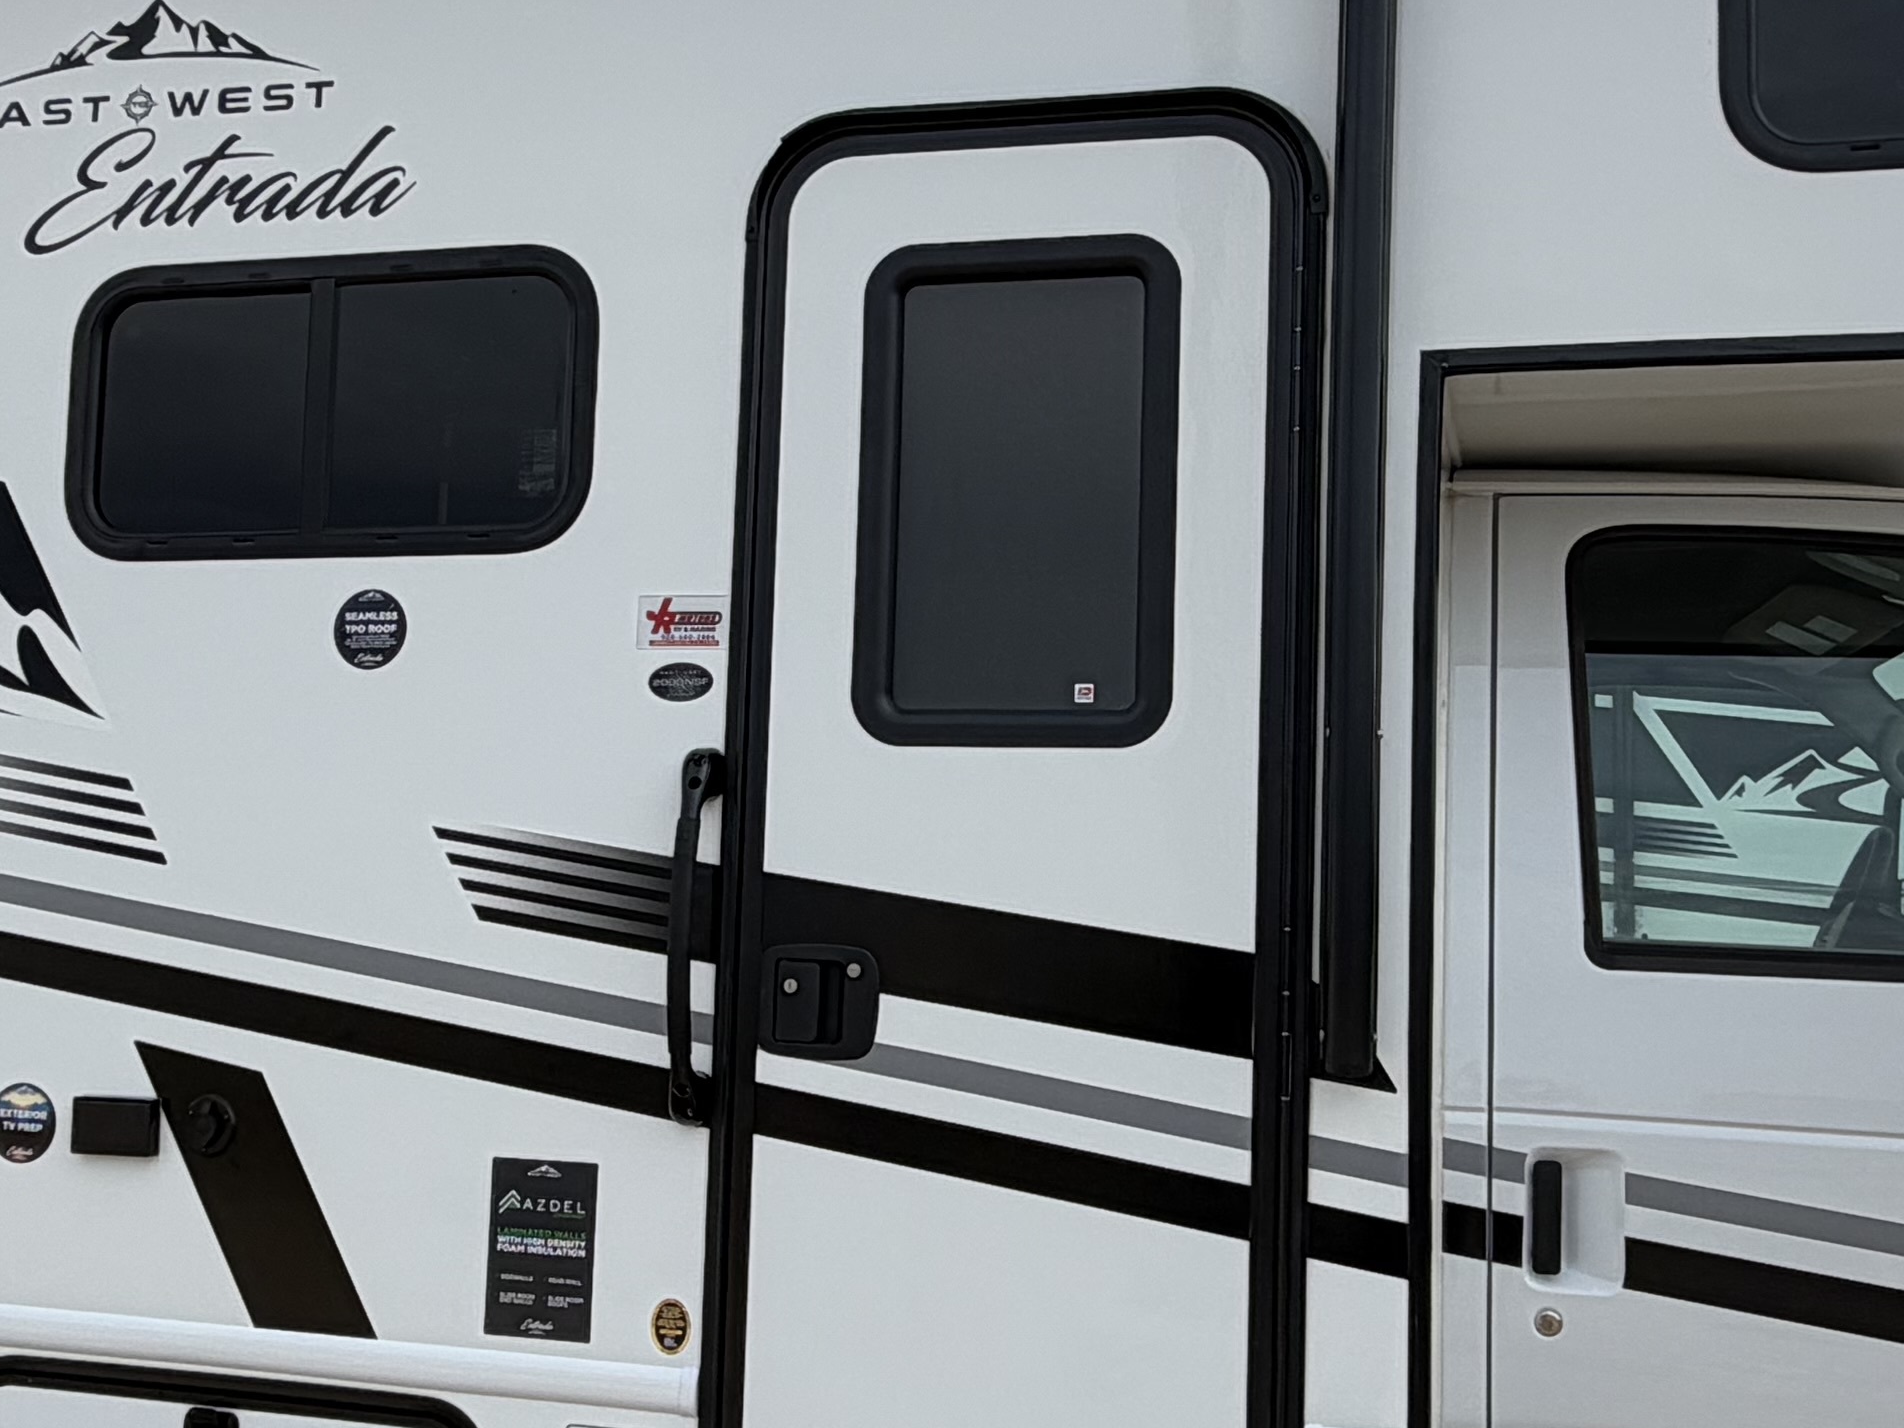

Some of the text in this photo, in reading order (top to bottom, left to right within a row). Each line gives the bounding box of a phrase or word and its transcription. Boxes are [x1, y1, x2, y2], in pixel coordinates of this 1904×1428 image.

[167, 80, 335, 118] WEST
[23, 124, 417, 256] Entrada
[345, 611, 398, 621] SEAMLESS
[345, 624, 397, 633] TPO ROOF
[0, 1108, 47, 1120] EXTERIOR
[2, 1121, 43, 1132] TV PREP
[523, 1198, 586, 1214] AZDEL
[497, 1234, 522, 1245] WITH
[547, 1238, 587, 1250] DENSITY
[496, 1243, 587, 1258] FOAM INSULATION
